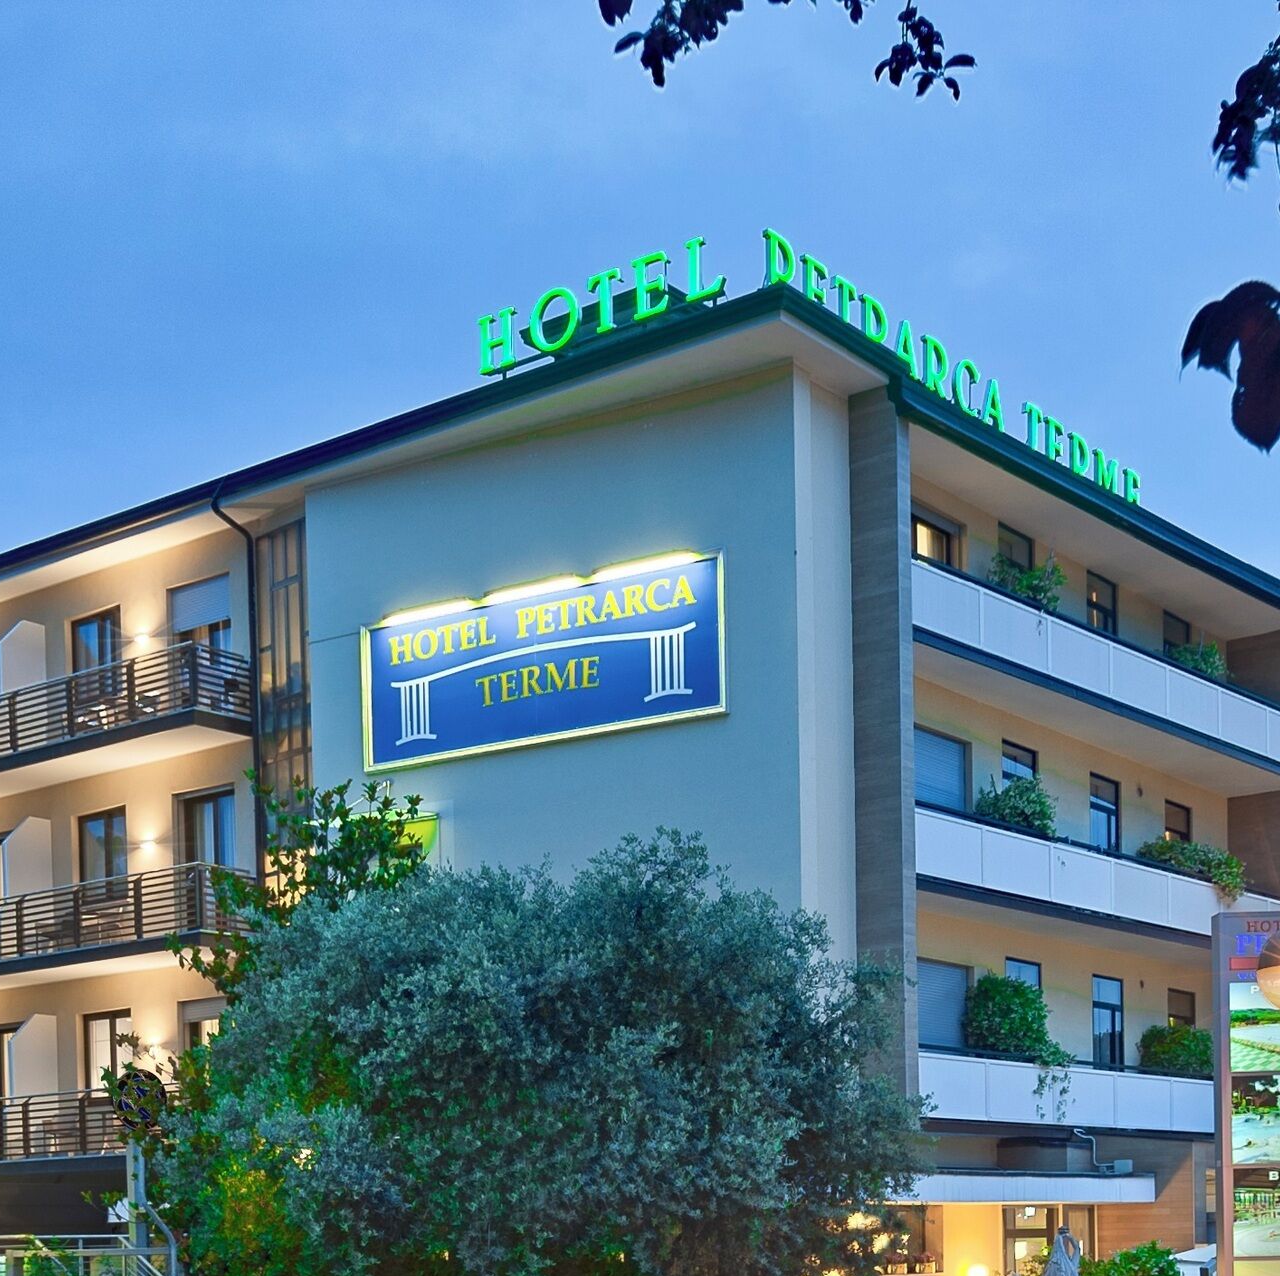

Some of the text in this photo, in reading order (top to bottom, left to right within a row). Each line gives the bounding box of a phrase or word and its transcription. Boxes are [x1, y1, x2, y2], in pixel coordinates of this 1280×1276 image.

[477, 236, 726, 375] HOTEL
[388, 576, 697, 666] HOTEL PETRARCA
[475, 656, 600, 708] TERME
